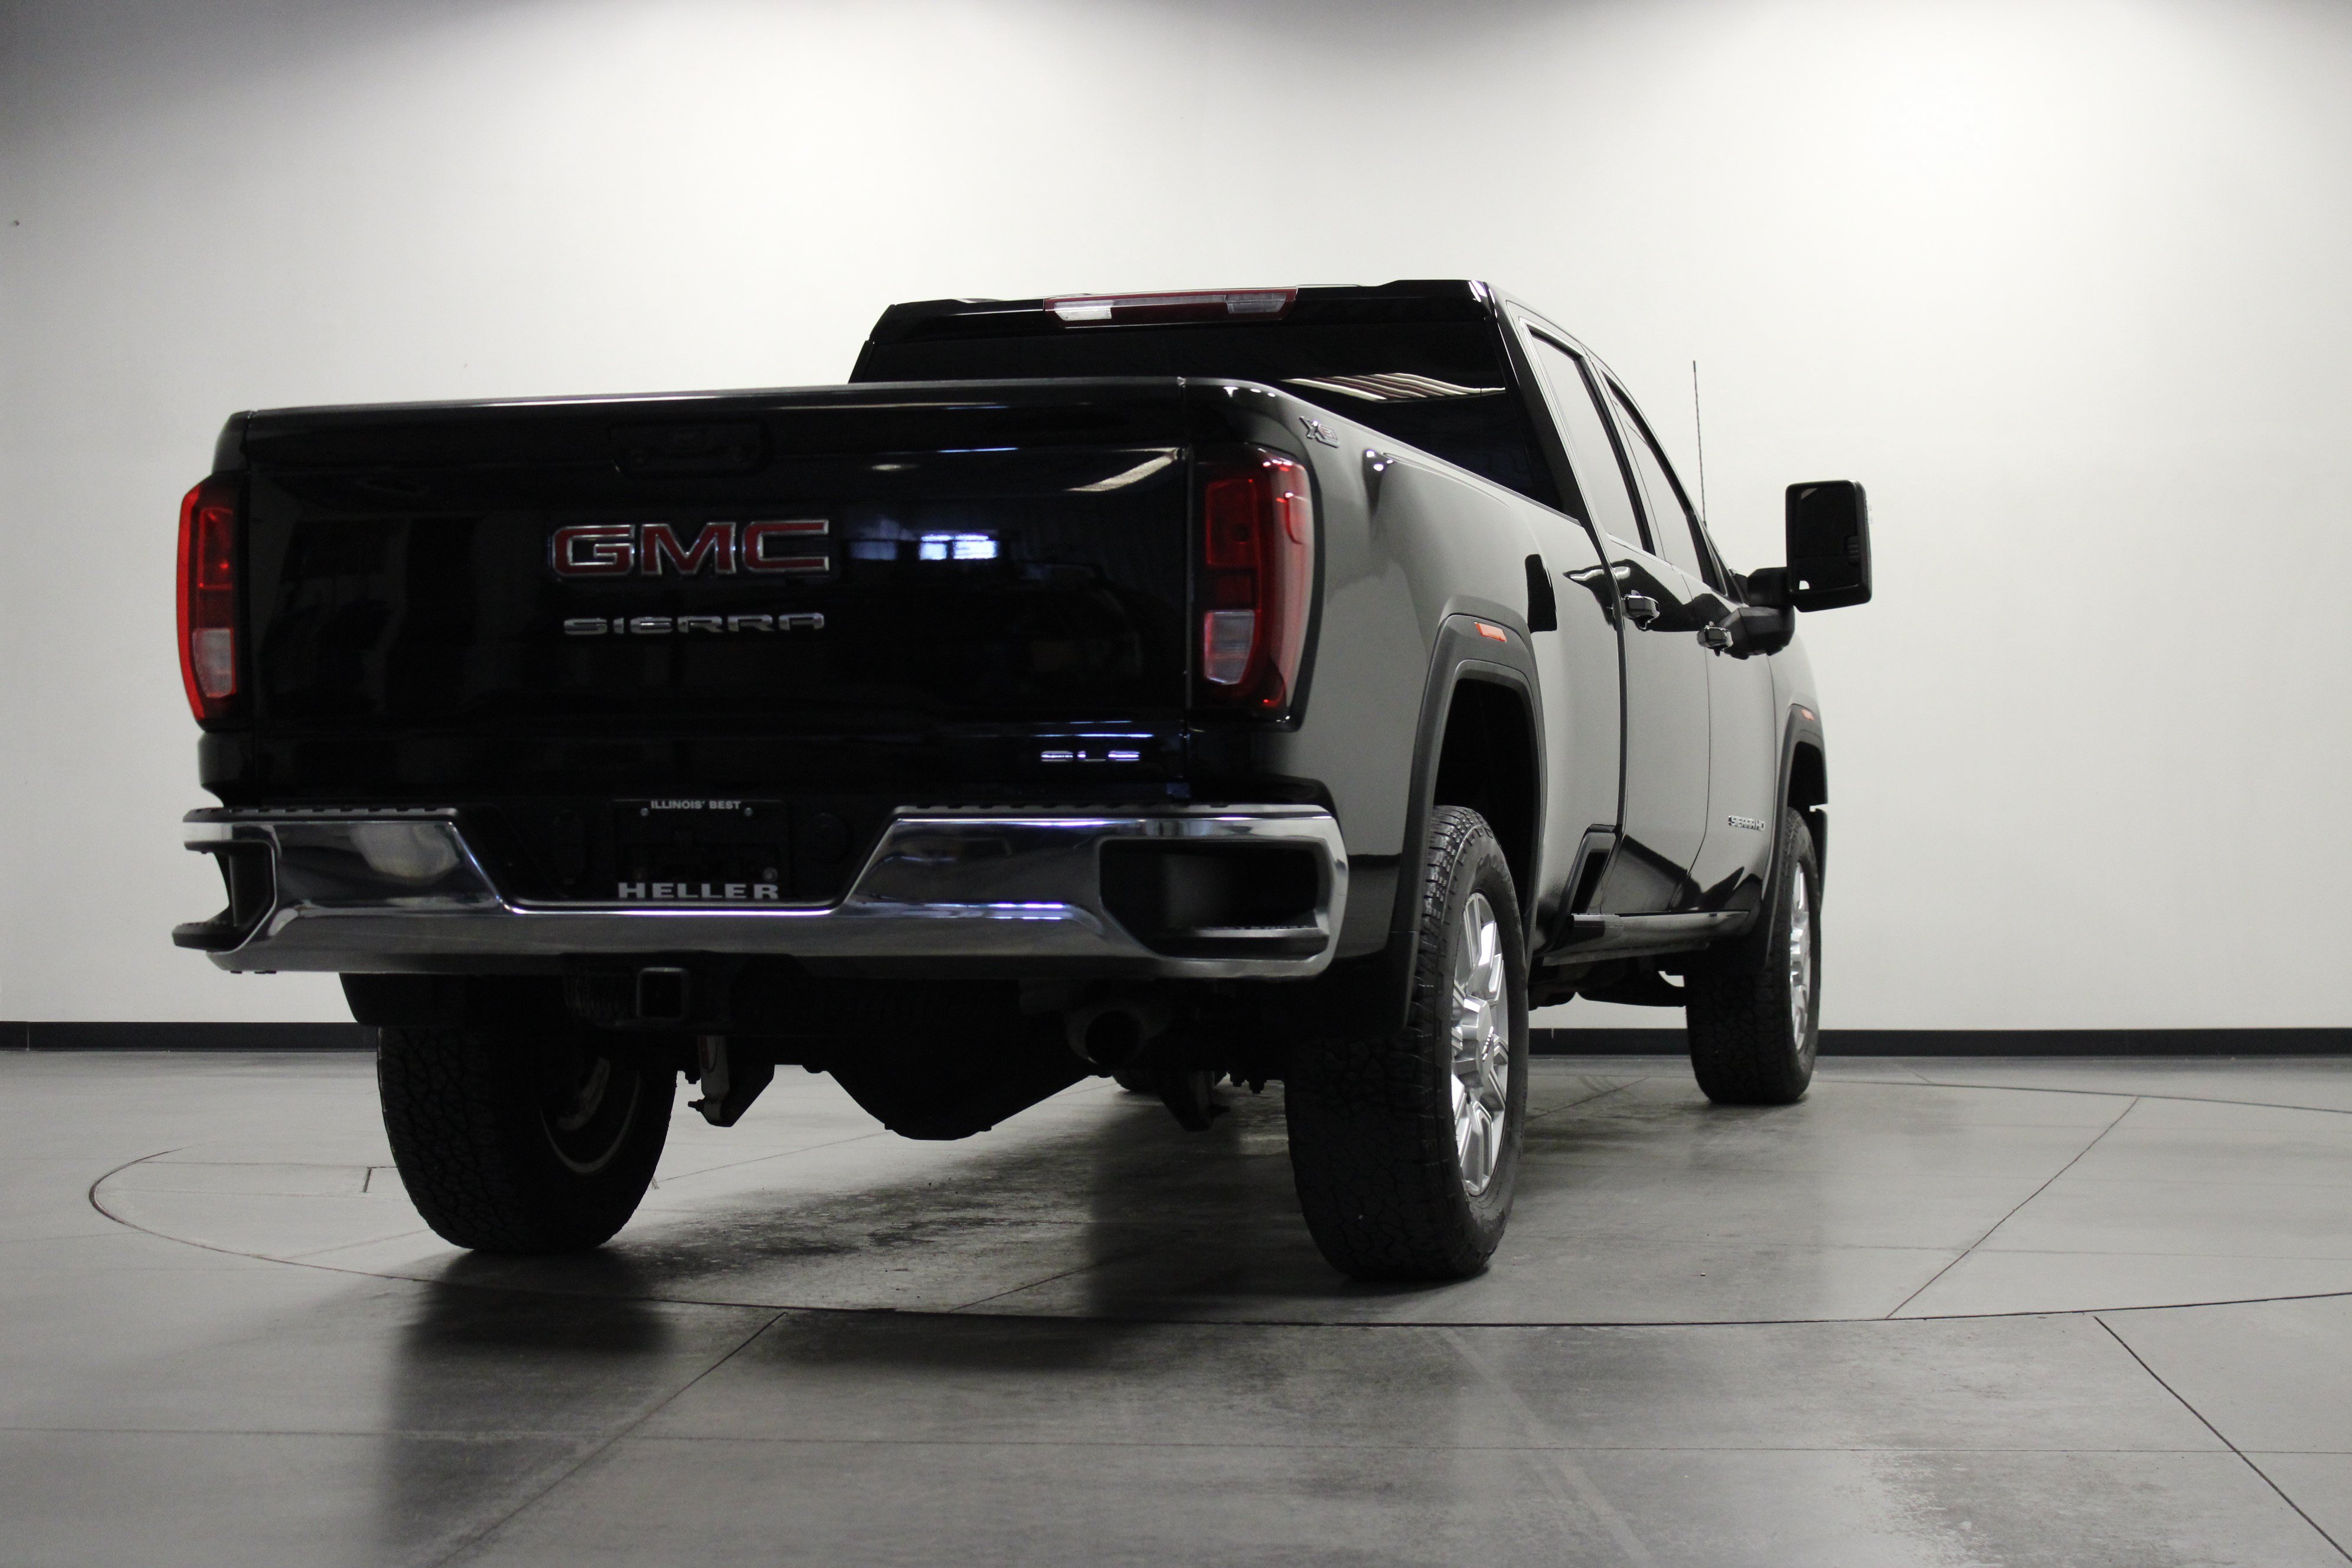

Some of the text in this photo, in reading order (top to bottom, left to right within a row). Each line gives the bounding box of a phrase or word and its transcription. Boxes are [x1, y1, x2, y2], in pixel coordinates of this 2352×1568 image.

[551, 520, 829, 577] GMC
[563, 612, 825, 635] SIERRA
[651, 800, 741, 809] ILLINOIS' BEST
[618, 883, 779, 900] HELLER
